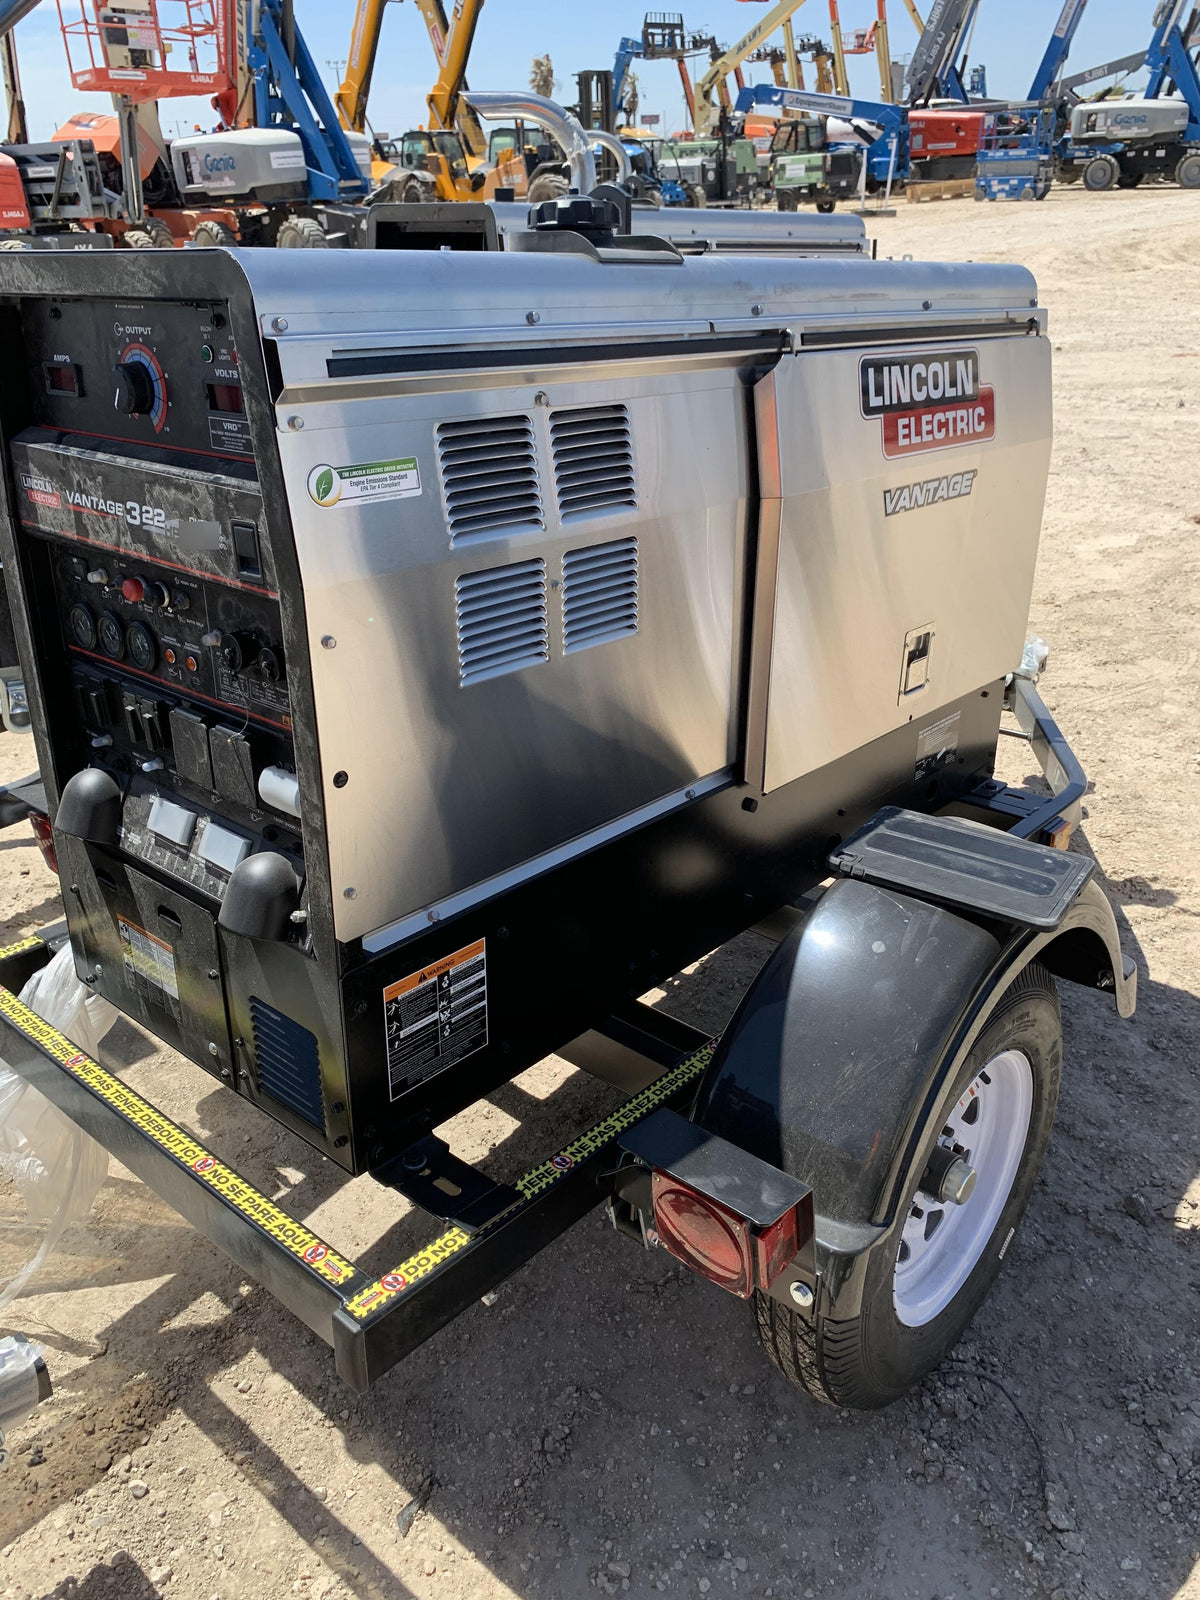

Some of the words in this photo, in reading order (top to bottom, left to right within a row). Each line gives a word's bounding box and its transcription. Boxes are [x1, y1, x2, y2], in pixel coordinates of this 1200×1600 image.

[236, 0, 244, 26] LIF
[1114, 113, 1148, 126] Genie
[204, 153, 236, 172] Genie
[126, 326, 152, 336] OUTPUT
[54, 354, 70, 362] AMPS
[214, 368, 238, 378] VOLTS
[868, 359, 973, 408] LINCOLN
[898, 406, 985, 446] ELECTRIC
[22, 476, 53, 494] LINCOLN
[350, 480, 366, 488] Engine
[366, 476, 388, 485] Emissions
[388, 473, 408, 482] Standard
[380, 481, 401, 490] Compliant
[32, 492, 58, 506] ELECTRIC
[66, 490, 124, 516] VANTAGE
[126, 500, 166, 528] 322
[428, 959, 455, 977] WARNING
[8, 1004, 28, 1018] NOT
[22, 1016, 50, 1038] STAND
[46, 1035, 74, 1058] HERE
[80, 1064, 96, 1076] NE
[91, 1074, 114, 1091] PAS
[111, 1088, 144, 1116] TENEZ
[140, 1114, 184, 1147] DEBOUT
[180, 1146, 200, 1160] ICI
[570, 1142, 591, 1158] NE
[589, 1124, 616, 1145] PAS
[614, 1096, 655, 1126] TENEZ
[652, 1066, 697, 1098] DEBOUT
[698, 1051, 713, 1064] ICI
[520, 1166, 558, 1194] HERE
[208, 1168, 230, 1184] NO
[226, 1182, 248, 1198] SE
[243, 1196, 279, 1224] PARE
[403, 1256, 432, 1276] DO
[431, 1232, 466, 1258] NOT
[326, 1260, 342, 1272] LINCOLN
[356, 1292, 378, 1307] LINCOLN
